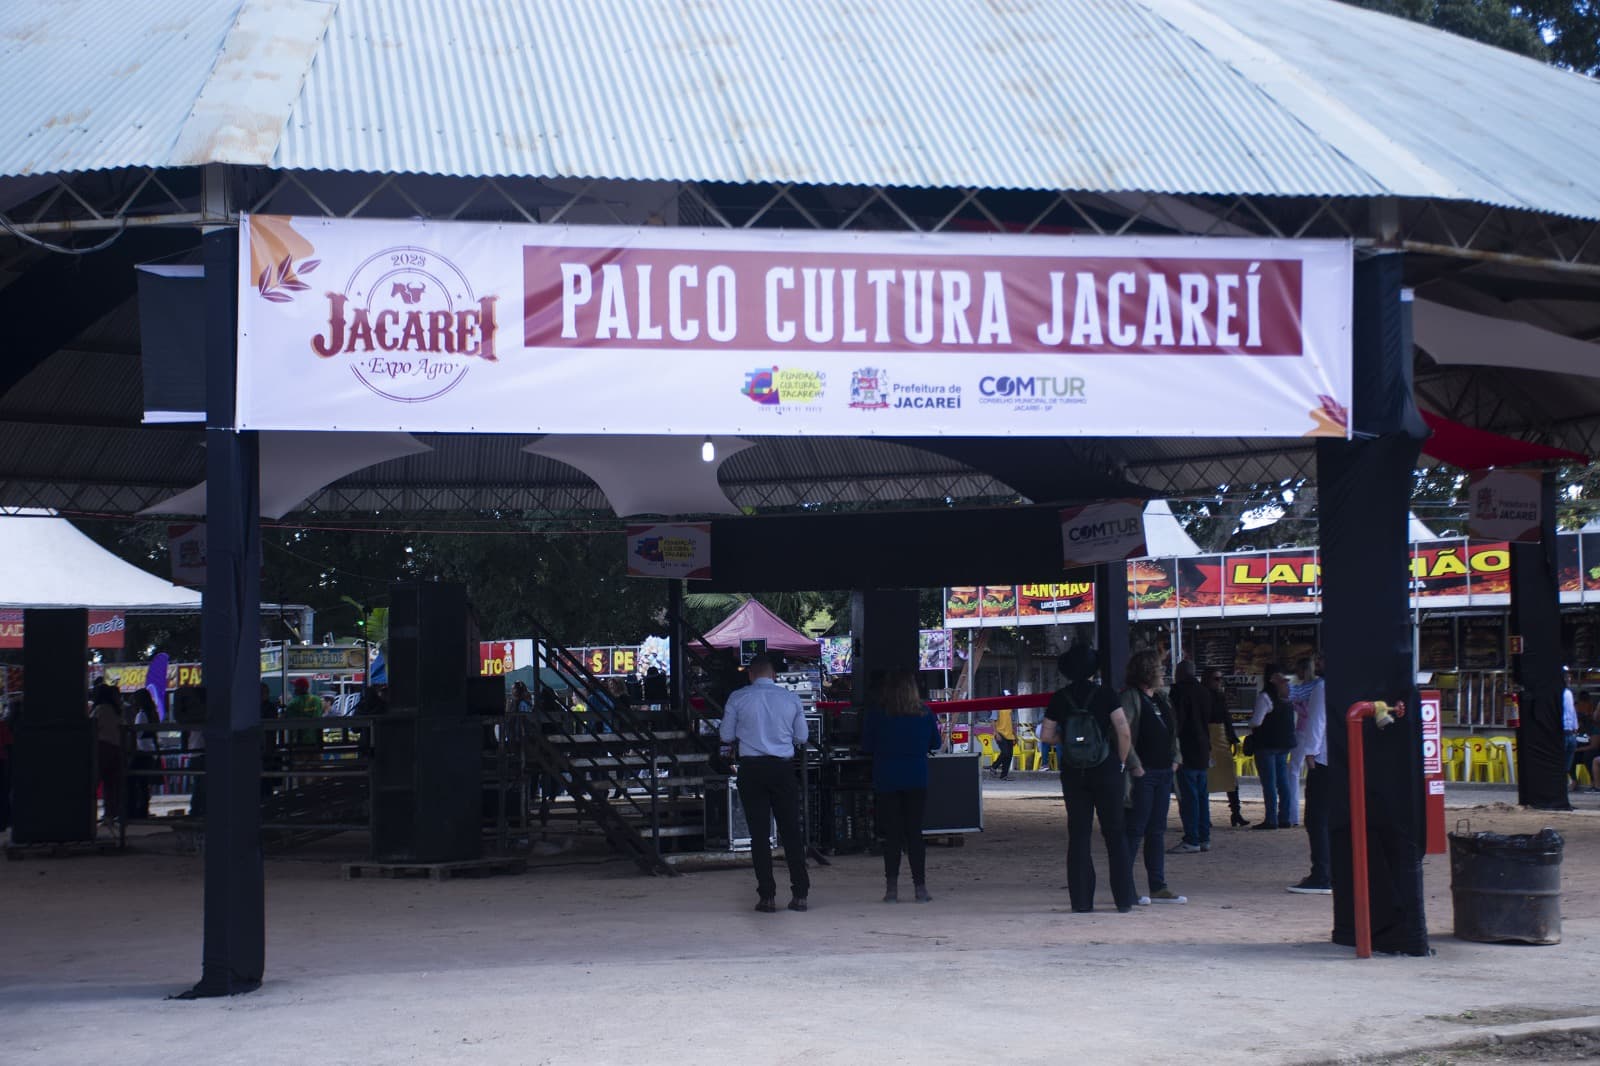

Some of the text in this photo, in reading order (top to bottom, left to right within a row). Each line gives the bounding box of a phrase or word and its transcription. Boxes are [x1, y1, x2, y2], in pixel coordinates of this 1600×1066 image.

[391, 254, 426, 267] 2023
[560, 262, 1262, 347] PALCO CULTURA JACAREÍ
[368, 357, 453, 381] Expo Agro
[893, 383, 962, 394] Prefeitura de
[979, 376, 1085, 397] COMTUR
[893, 396, 961, 409] JACAREÍ
[1069, 518, 1138, 541] COMTUR
